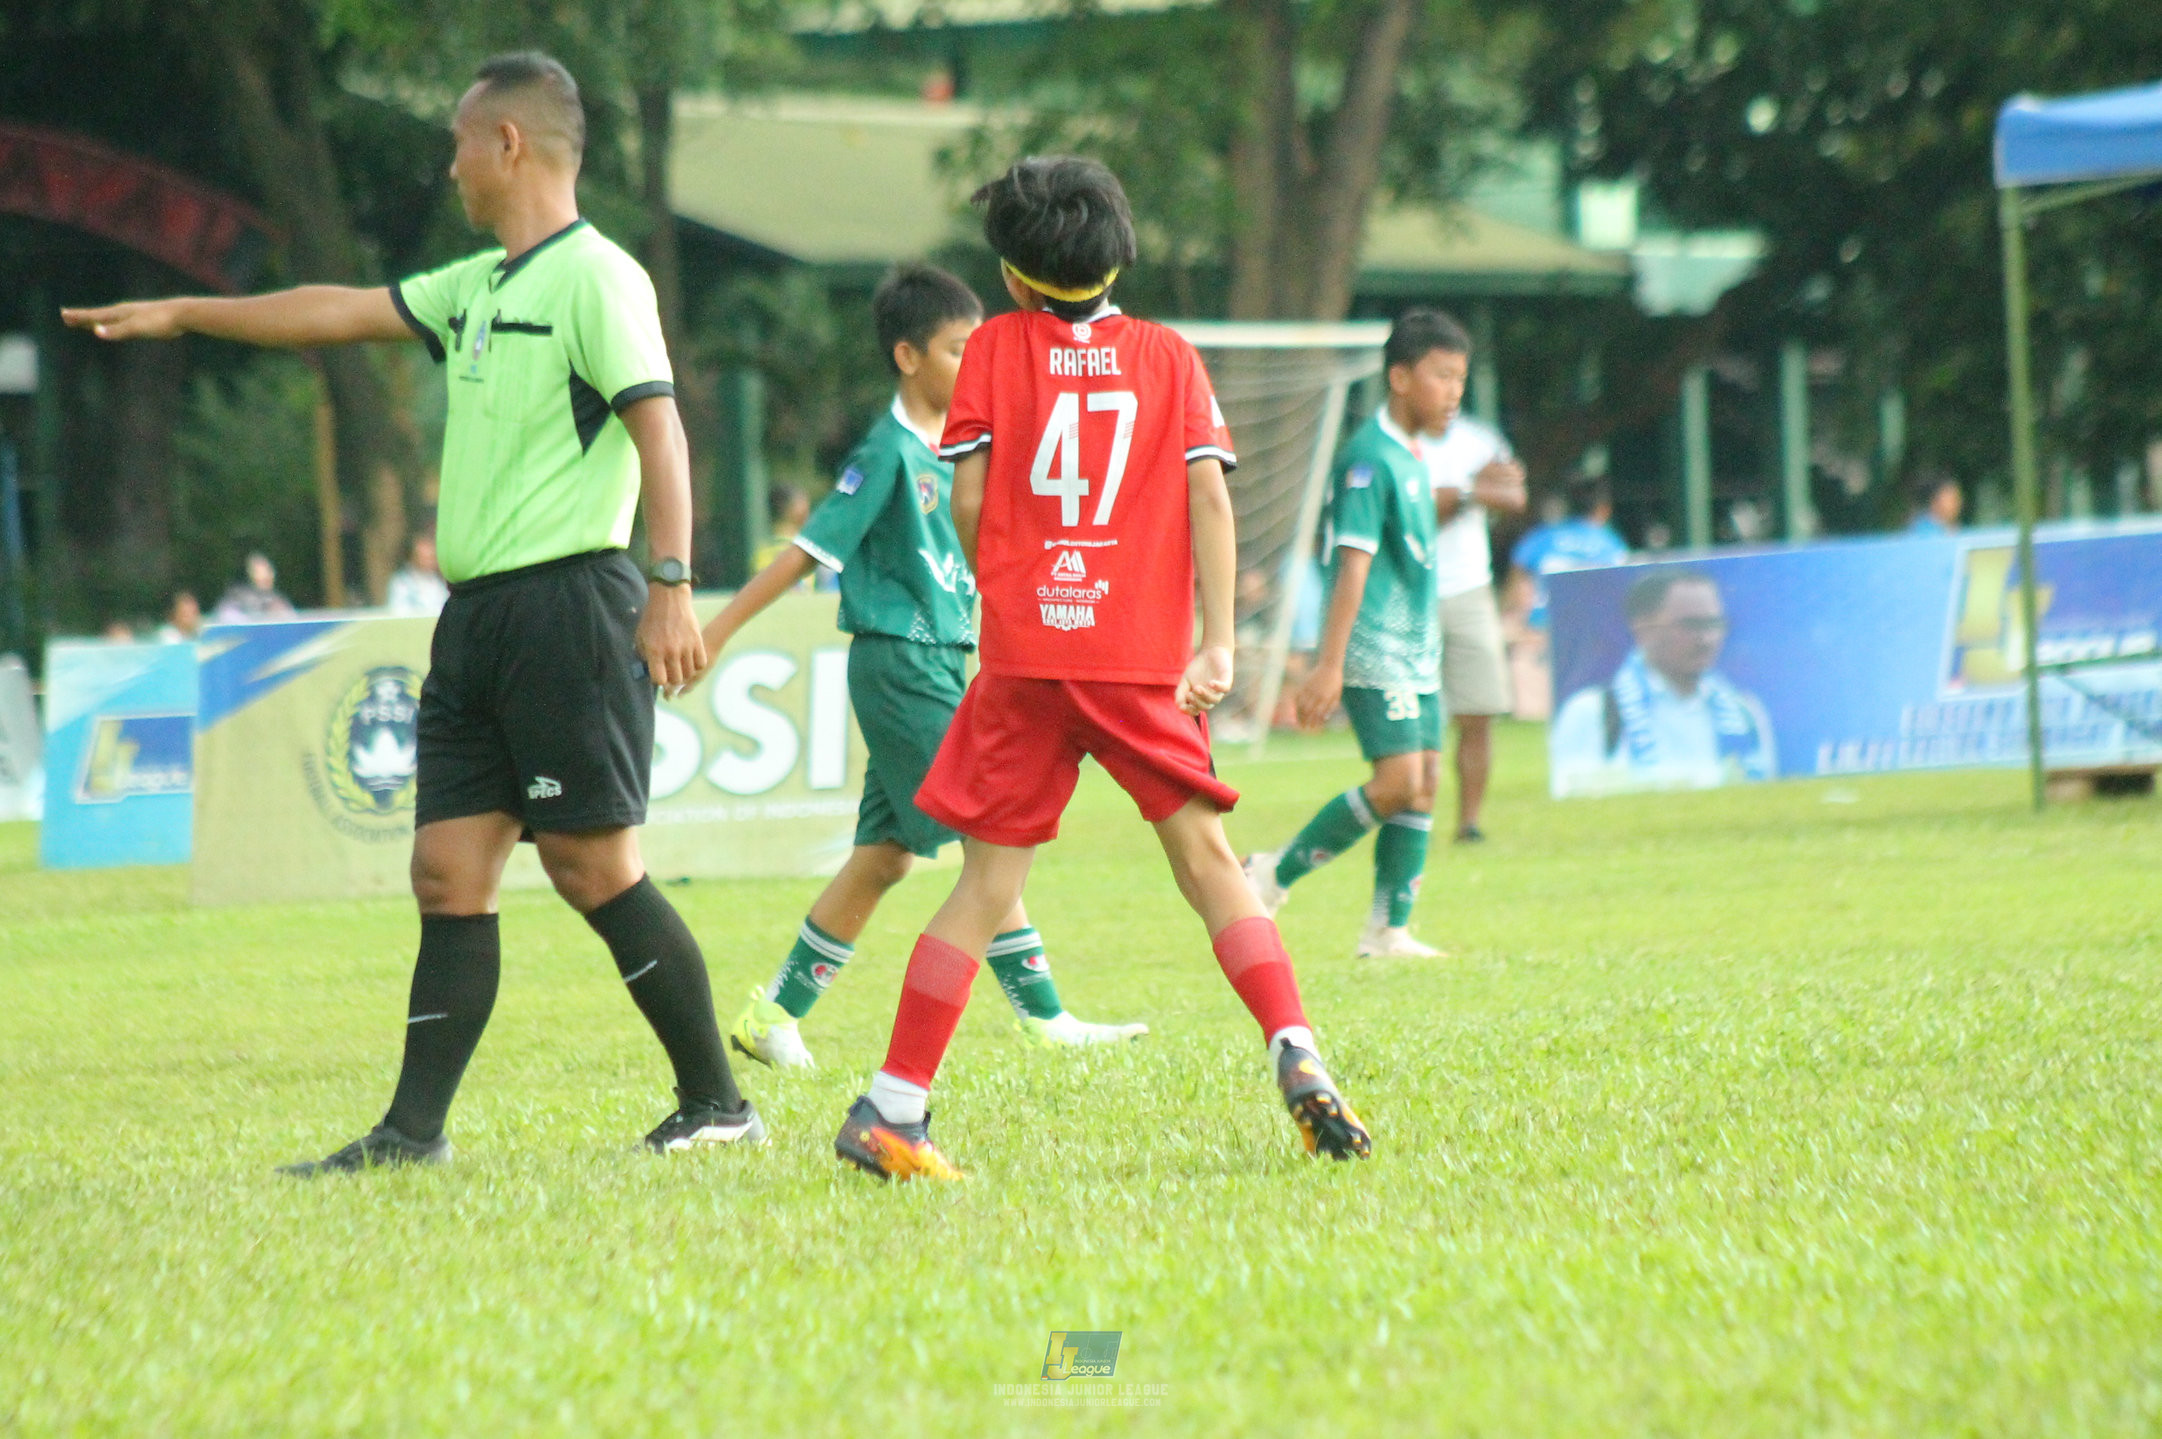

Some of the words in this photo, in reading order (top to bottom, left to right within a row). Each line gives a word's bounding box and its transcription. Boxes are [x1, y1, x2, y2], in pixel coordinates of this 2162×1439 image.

[1049, 347, 1122, 377] RAFAEL
[1029, 391, 1139, 527] 47
[1036, 585, 1102, 600] dutalaras
[1039, 603, 1096, 628] YAMAHA
